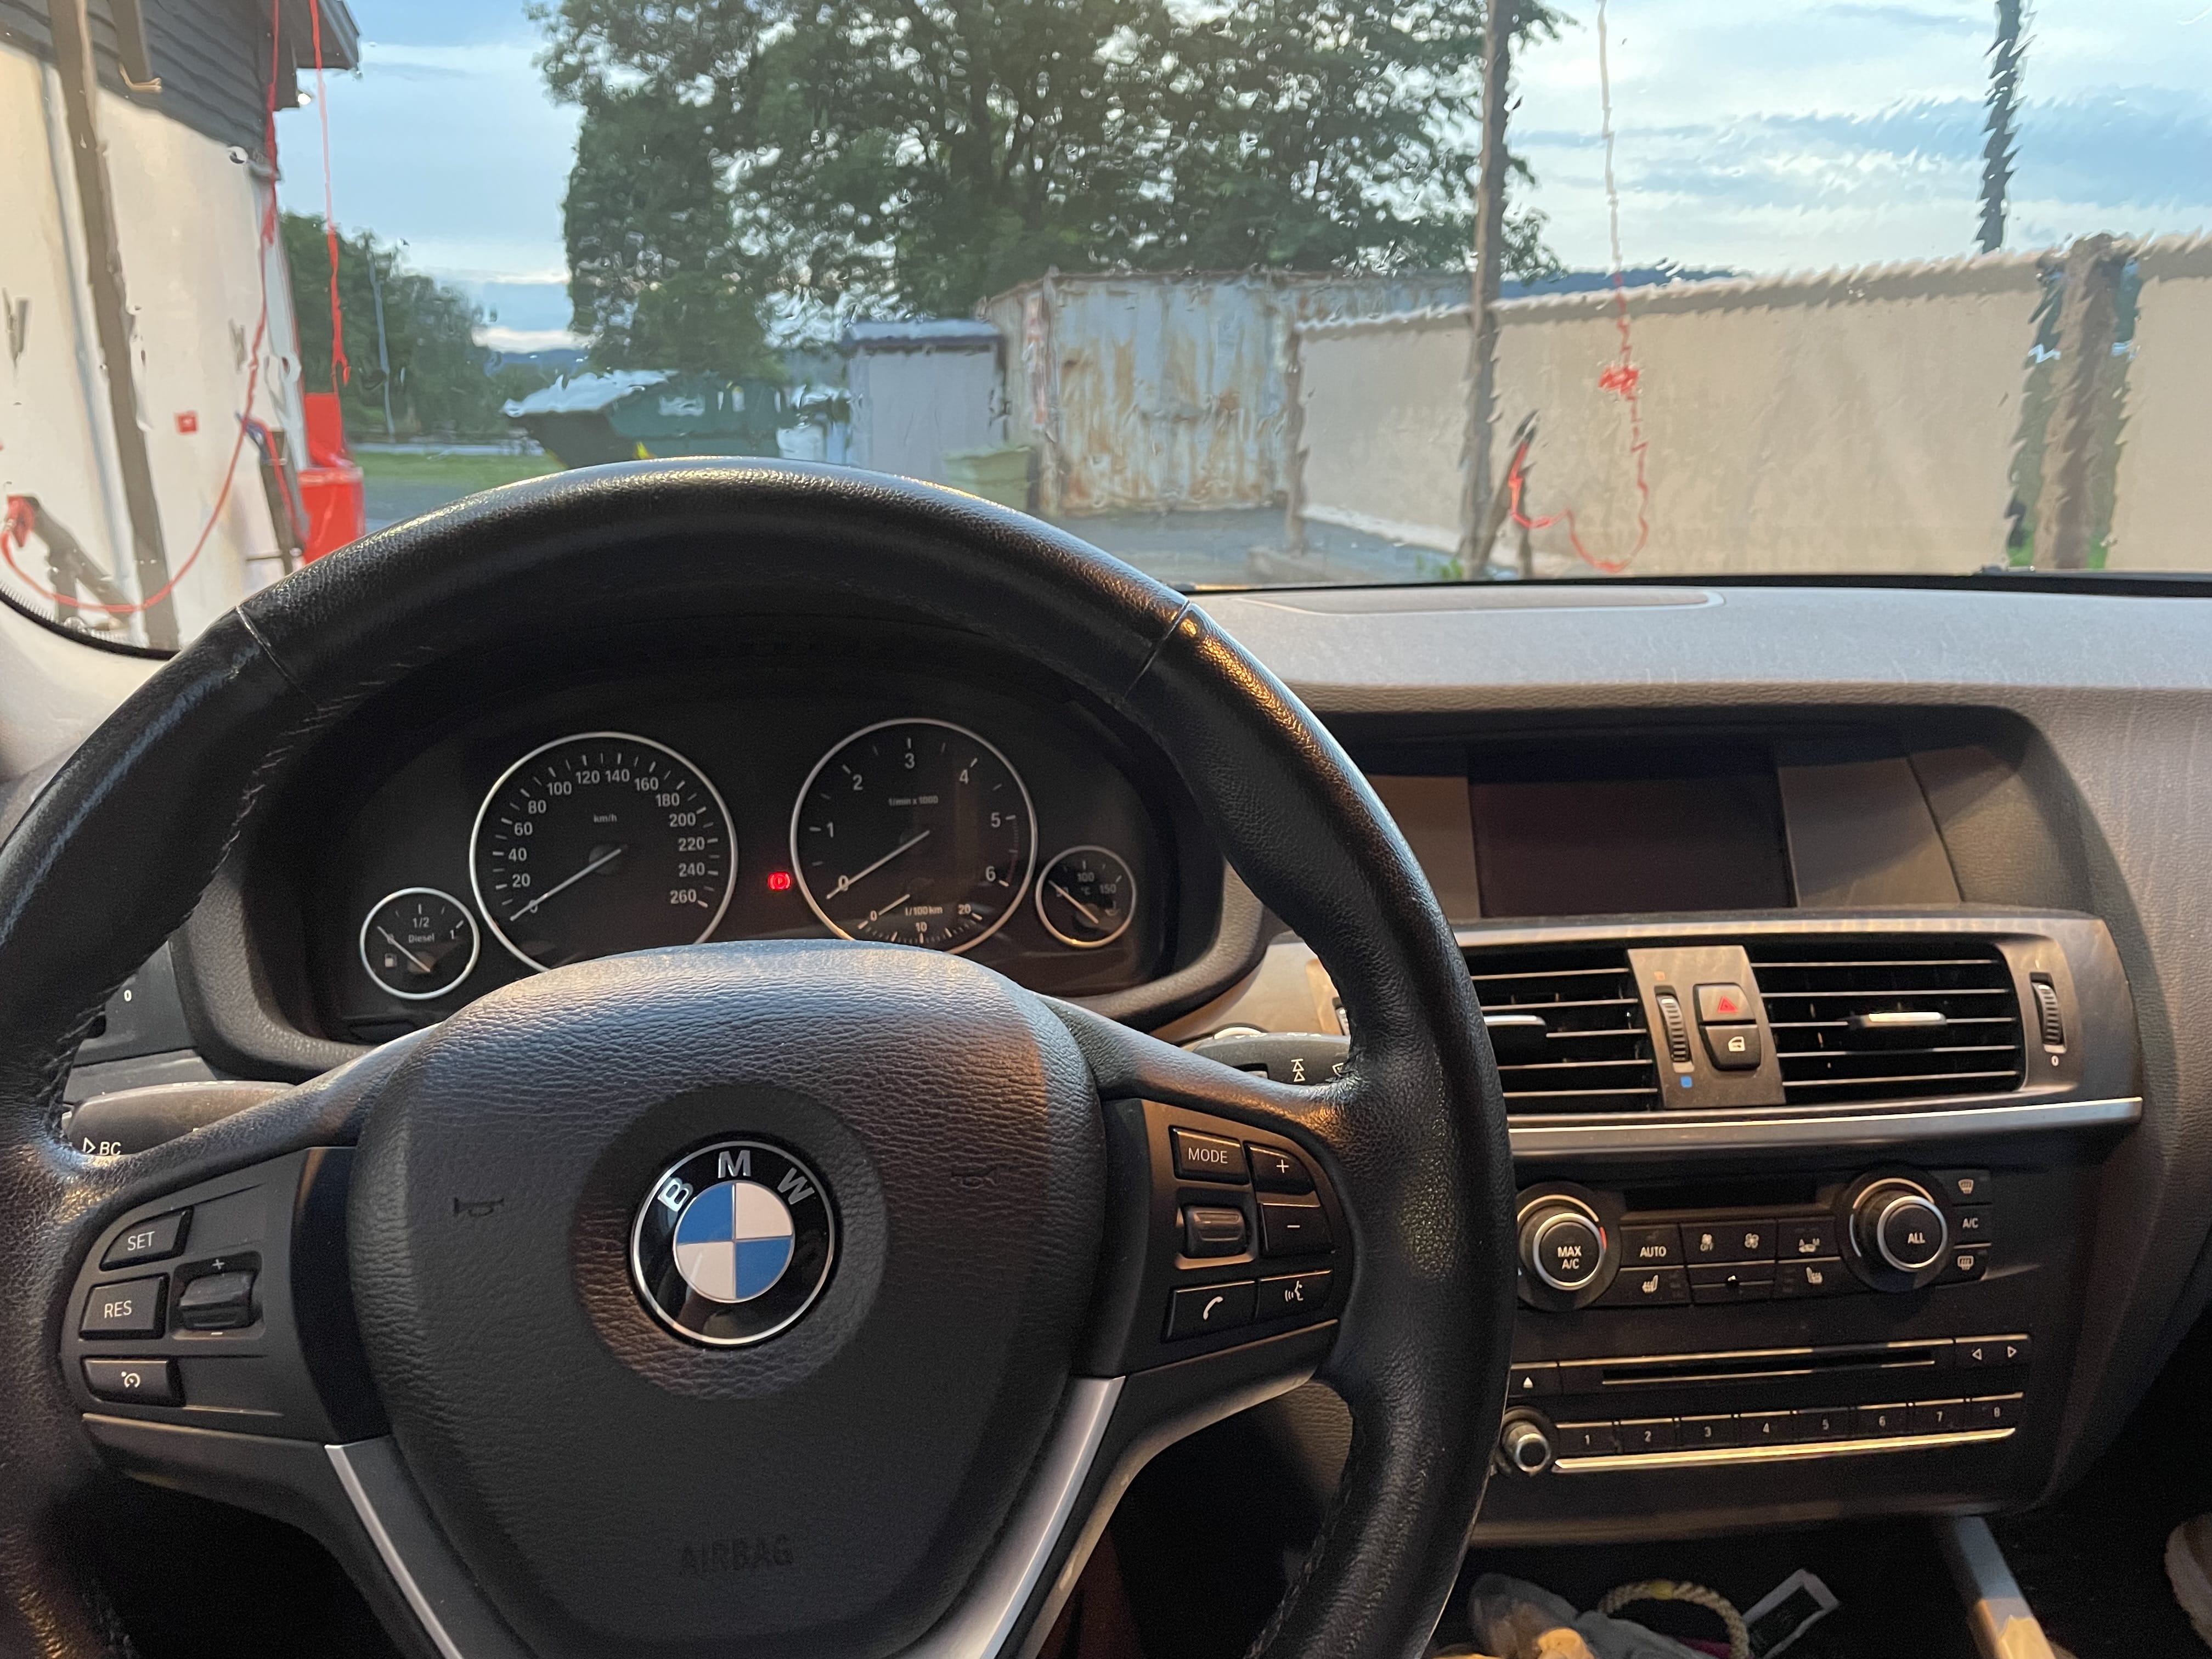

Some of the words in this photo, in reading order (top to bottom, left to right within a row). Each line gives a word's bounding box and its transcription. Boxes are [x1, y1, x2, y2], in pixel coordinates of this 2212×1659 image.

[905, 753, 915, 769] 3
[576, 771, 600, 784] 120
[606, 769, 630, 782] 140
[959, 770, 969, 784] 4
[548, 782, 572, 795] 100
[635, 777, 658, 791] 160
[853, 775, 863, 791] 2
[528, 800, 547, 814] 80
[656, 793, 680, 807] 180
[594, 814, 617, 823] km/h
[669, 813, 696, 827] 200
[991, 812, 1001, 827] 5
[515, 822, 533, 836] 60
[827, 822, 834, 838] 1
[679, 837, 704, 851] 220
[509, 848, 527, 862] 40
[679, 862, 705, 877] 240
[986, 866, 996, 881] 6
[512, 874, 531, 888] 20
[838, 875, 849, 891] 0
[1099, 884, 1117, 894] 150
[670, 890, 696, 904] 260
[870, 910, 877, 921] 0
[958, 904, 971, 915] 20
[413, 917, 430, 928] 1/2
[916, 922, 927, 932] 10
[408, 933, 435, 944] Diesel
[450, 930, 454, 939] 1
[124, 990, 132, 1001] 0
[2051, 1056, 2059, 1066] 0
[99, 1142, 121, 1155] BC
[1188, 1147, 1228, 1164] MODE
[1962, 1218, 1978, 1229] A/C
[127, 1231, 155, 1251] SET
[1908, 1233, 1925, 1244] ALL
[1558, 1245, 1582, 1257] MAX
[1640, 1246, 1666, 1257] AUTO
[1562, 1258, 1579, 1269] A/C
[104, 1300, 132, 1318] RES
[1584, 1434, 1590, 1444] 1
[1645, 1431, 1652, 1442] 2
[1705, 1426, 1712, 1437] 3
[1763, 1423, 1770, 1433] 4
[1822, 1419, 1829, 1430] 5
[1879, 1415, 1886, 1426] 6
[1937, 1410, 1943, 1422] 7
[1994, 1407, 2000, 1418] 8
[681, 1534, 793, 1573] AIRBAG
